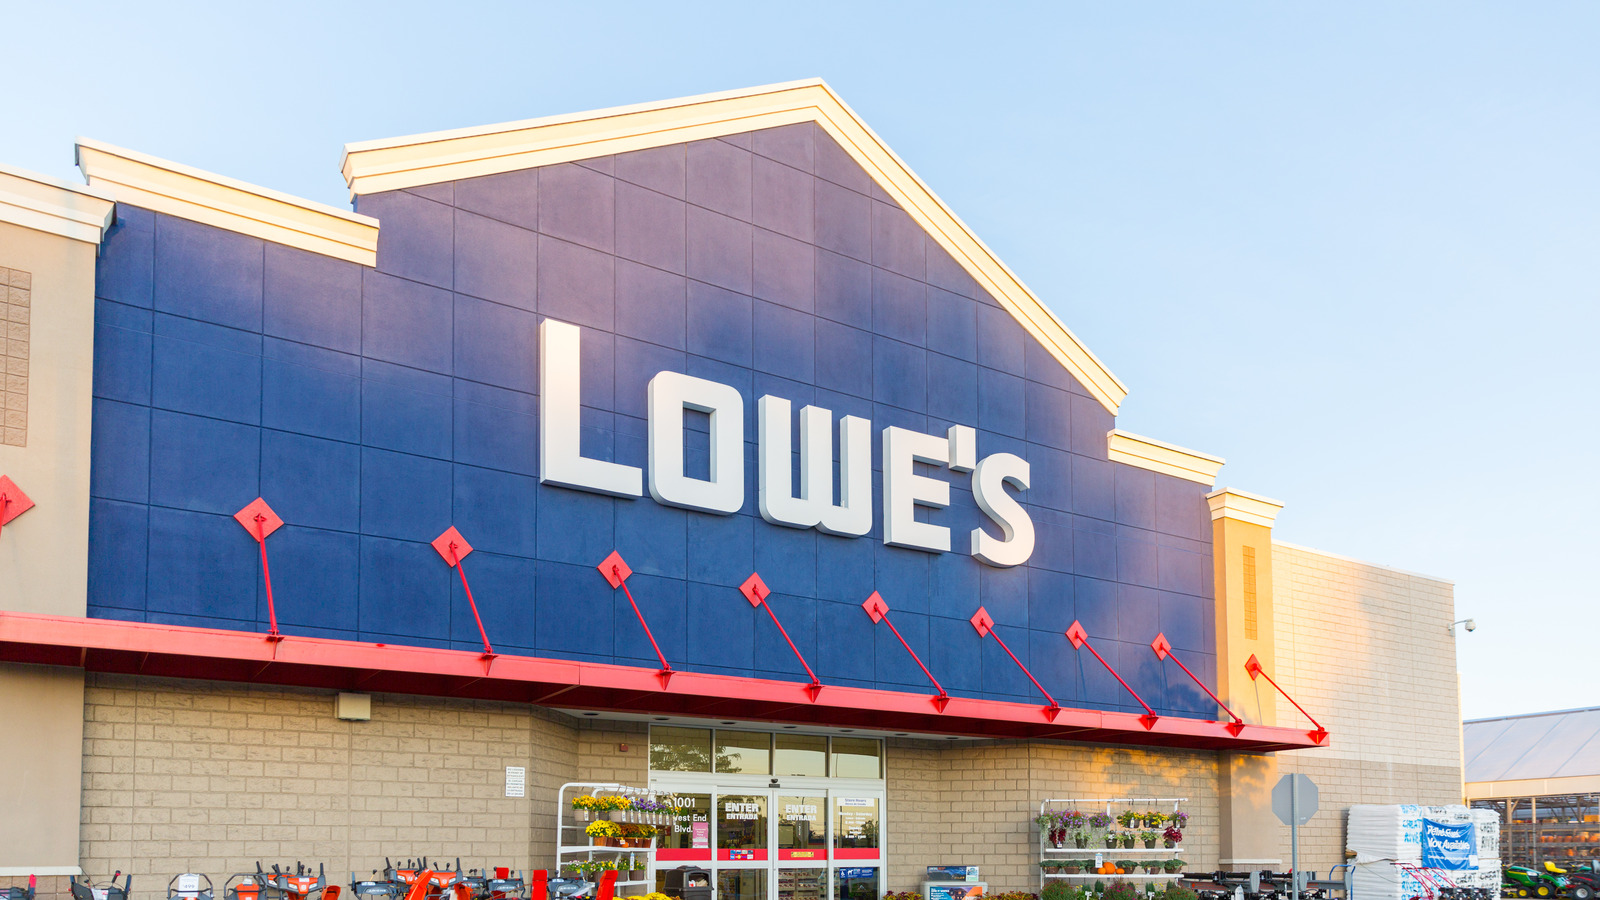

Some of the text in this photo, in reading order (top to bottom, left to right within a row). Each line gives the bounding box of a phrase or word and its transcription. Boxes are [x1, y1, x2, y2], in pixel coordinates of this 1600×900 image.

[540, 318, 1035, 568] LOWE'S
[674, 797, 696, 808] 1001
[725, 802, 759, 812] ENTER
[785, 804, 817, 814] ENTER
[692, 813, 707, 822] End
[674, 824, 693, 833] Blvd.
